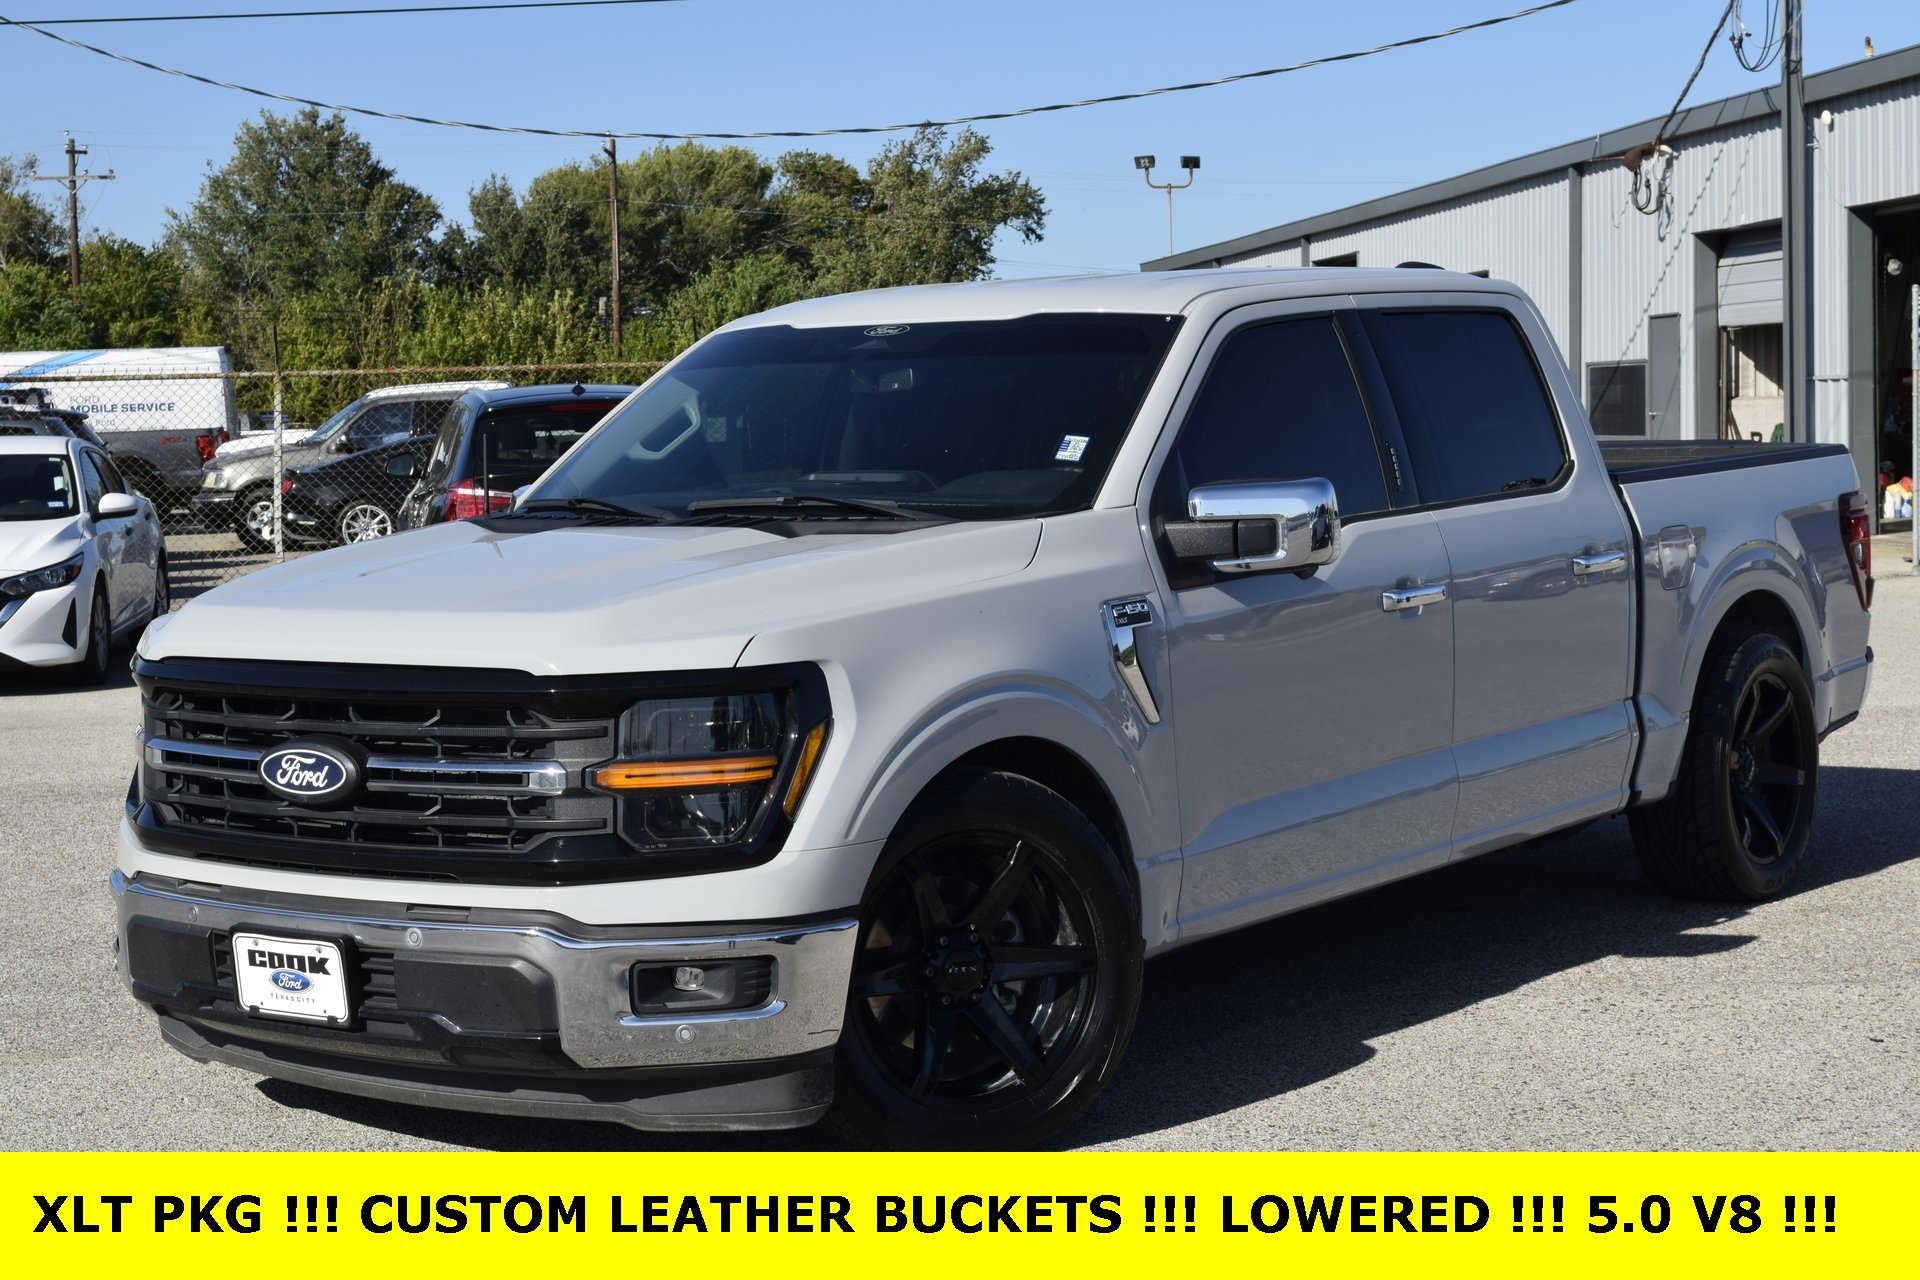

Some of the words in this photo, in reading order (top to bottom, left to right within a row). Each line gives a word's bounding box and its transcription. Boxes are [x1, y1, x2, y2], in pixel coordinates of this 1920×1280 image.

[69, 395, 100, 404] FORD
[70, 403, 118, 413] MOBILE
[120, 402, 176, 413] SERVICE
[1112, 602, 1149, 617] F-150
[276, 754, 330, 788] Ford
[247, 948, 332, 976] COOK
[278, 971, 303, 990] Ford
[270, 992, 295, 1002] TEXAS
[296, 996, 316, 1004] CITY
